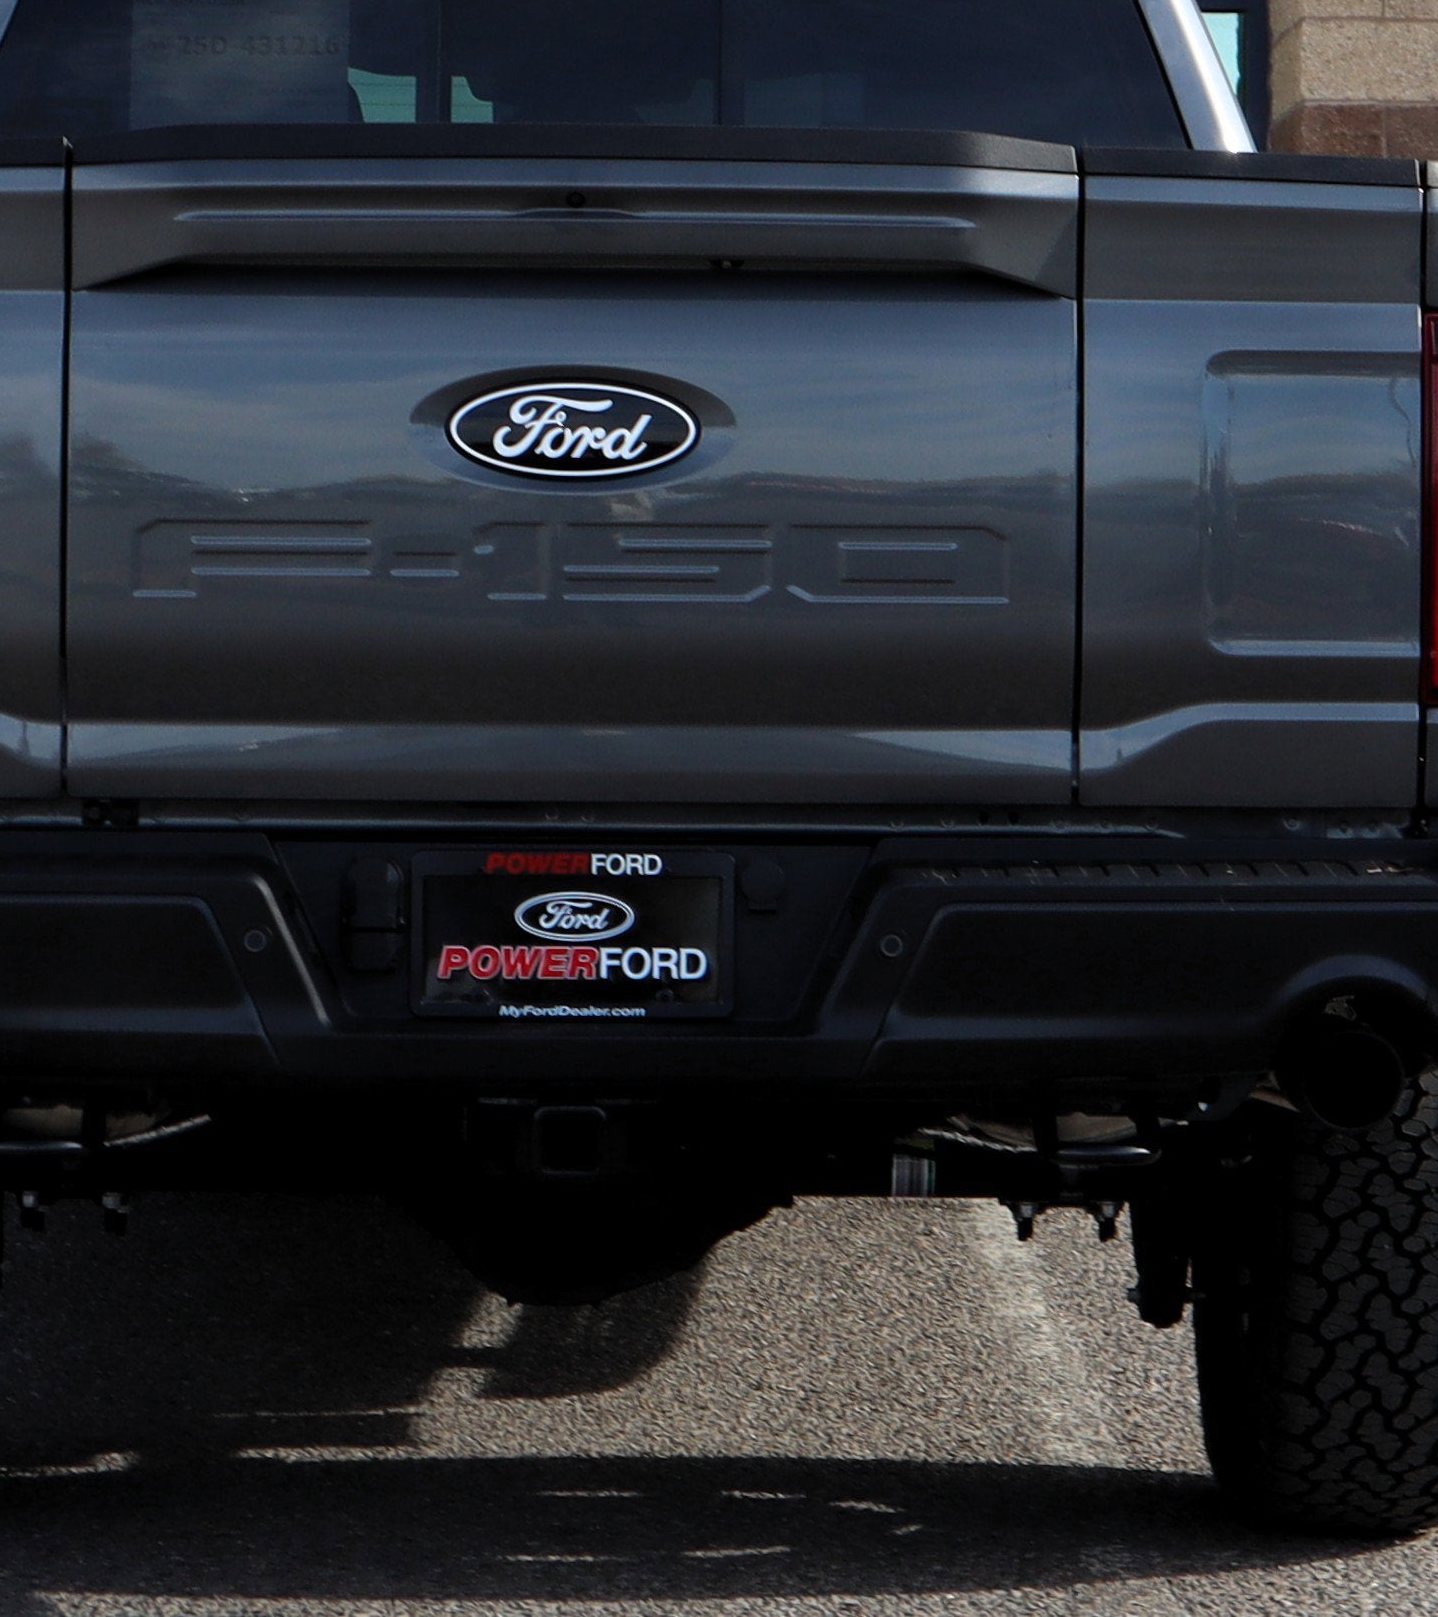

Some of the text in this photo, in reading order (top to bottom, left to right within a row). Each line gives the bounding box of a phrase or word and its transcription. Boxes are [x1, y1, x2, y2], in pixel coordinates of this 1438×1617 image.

[493, 394, 651, 462] Ford
[133, 518, 1010, 604] F-150
[538, 901, 609, 930] Ford
[499, 1005, 645, 1018] MyFordDealer.com
